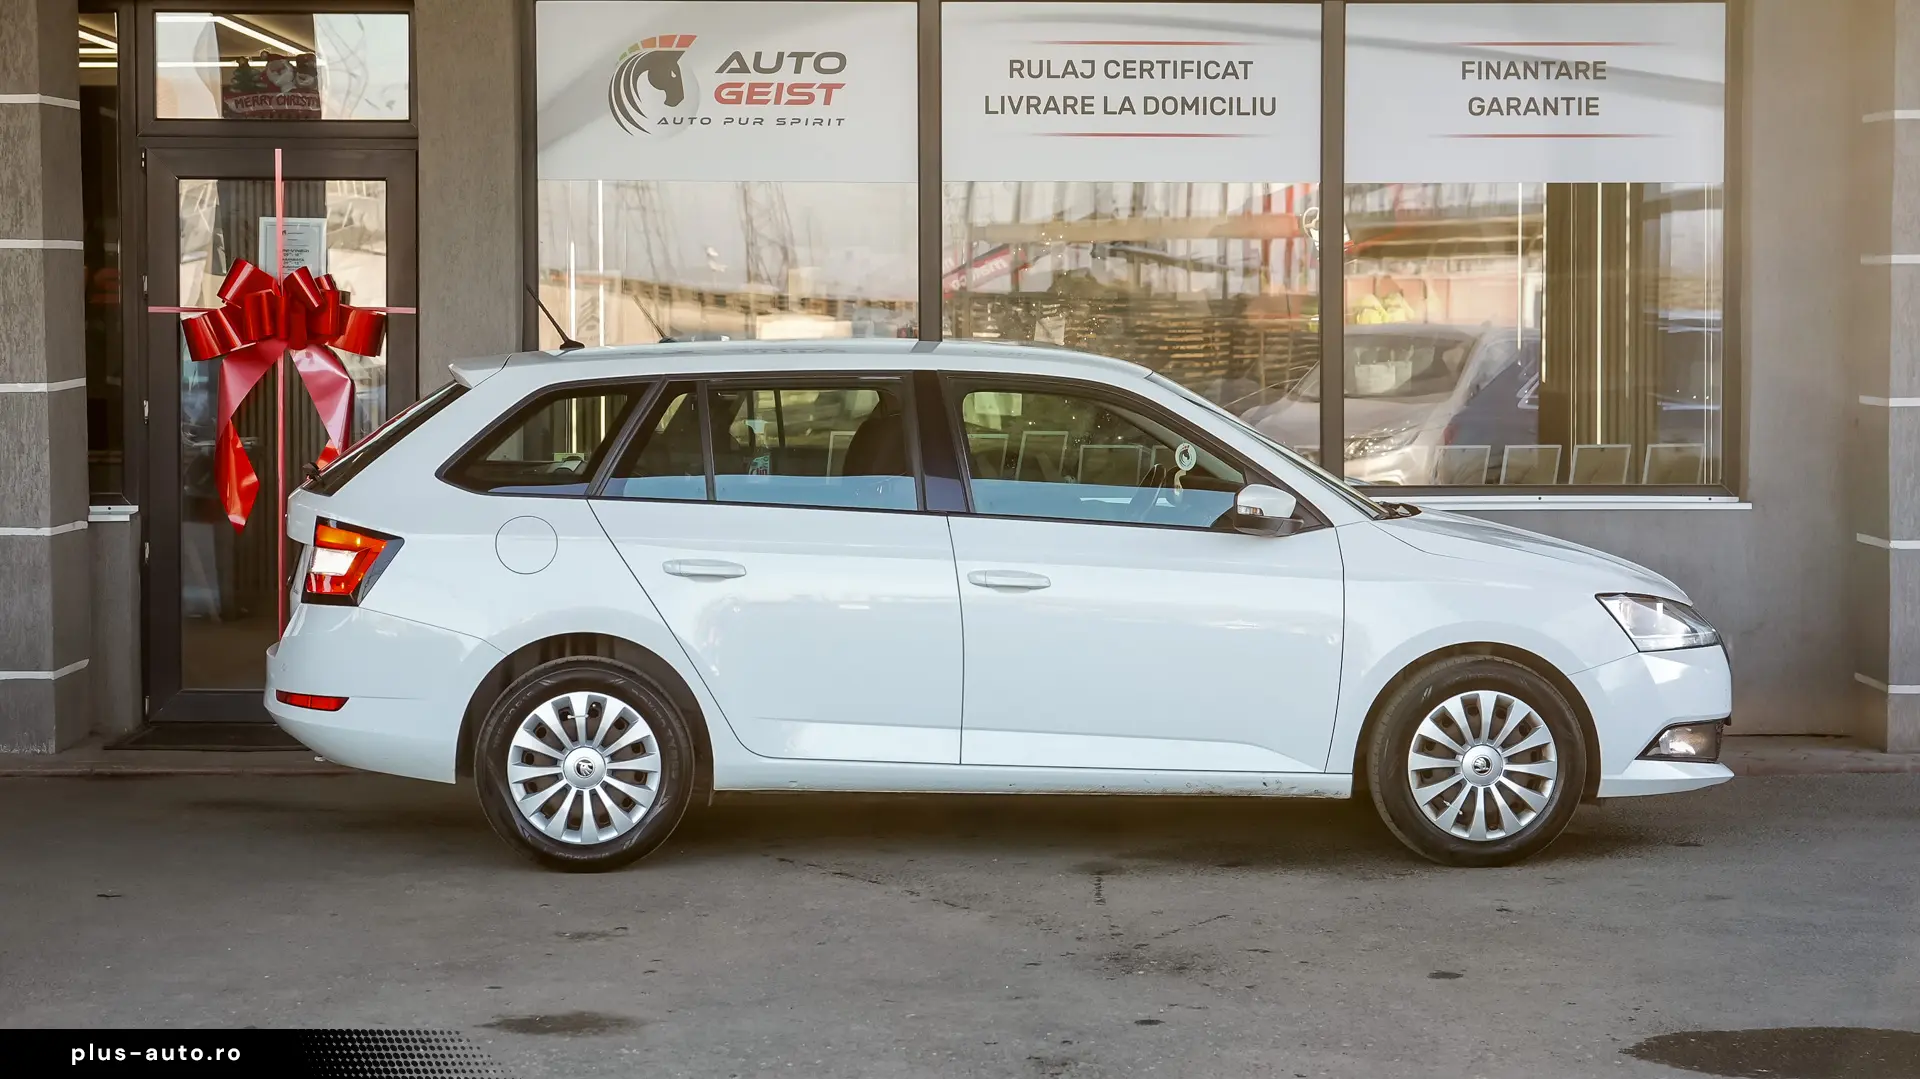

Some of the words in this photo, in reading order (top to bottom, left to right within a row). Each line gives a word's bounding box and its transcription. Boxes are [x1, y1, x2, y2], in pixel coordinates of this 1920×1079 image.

[715, 51, 847, 75] AUTO
[1009, 58, 1097, 80] RULAJ
[1103, 59, 1254, 80] CERTIFICAT
[1461, 60, 1607, 80] FINANTARE
[234, 95, 274, 109] MERRY
[714, 82, 846, 106] GEIST
[984, 95, 1096, 116] LIVRARE
[1103, 95, 1137, 116] LA
[1143, 95, 1277, 117] DOMICILIU
[1467, 96, 1600, 117] GARANTIE
[656, 116, 712, 127] AUTO
[723, 117, 765, 127] PUR
[775, 117, 845, 126] SPIRIT
